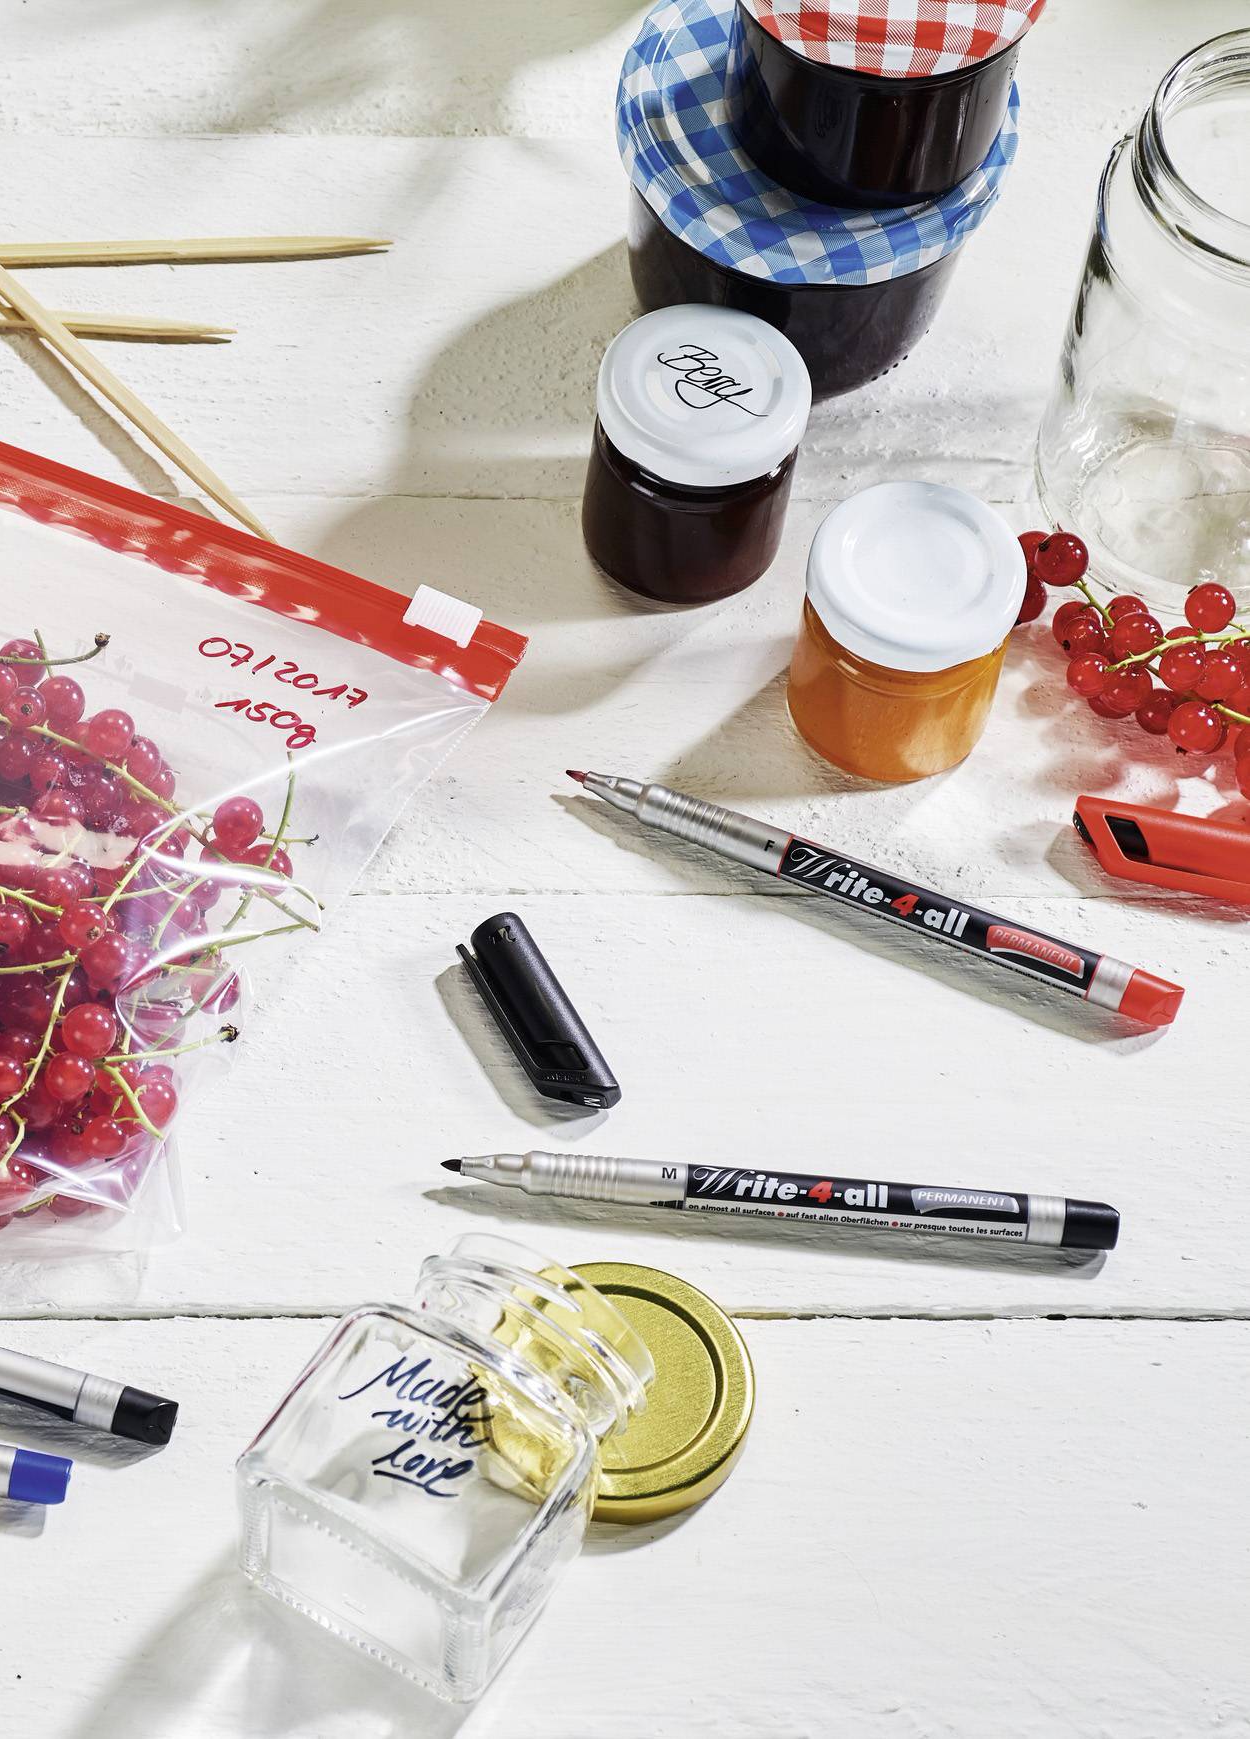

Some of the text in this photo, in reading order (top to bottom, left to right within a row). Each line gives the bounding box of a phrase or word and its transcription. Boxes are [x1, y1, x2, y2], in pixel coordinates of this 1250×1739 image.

[198, 637, 368, 709] 07/2017
[214, 698, 316, 749] 150g
[763, 839, 776, 852] F
[789, 847, 970, 938] Write-4-all
[992, 929, 1079, 967] PERMANENT
[661, 1167, 678, 1180] M
[693, 1166, 1008, 1208] Write-4-all PERMANENT
[700, 1203, 728, 1213] almost
[742, 1208, 776, 1217] surfaces
[785, 1211, 800, 1219] auf
[801, 1212, 816, 1220] fast
[818, 1214, 838, 1222] allen
[840, 1215, 890, 1227] Oberflächen
[914, 1222, 946, 1232] presque
[948, 1224, 974, 1234] toutes
[976, 1226, 988, 1235] les
[989, 1227, 1023, 1238] surfaces
[338, 1356, 495, 1422] Made
[372, 1409, 490, 1448] with
[372, 1438, 474, 1497] love
